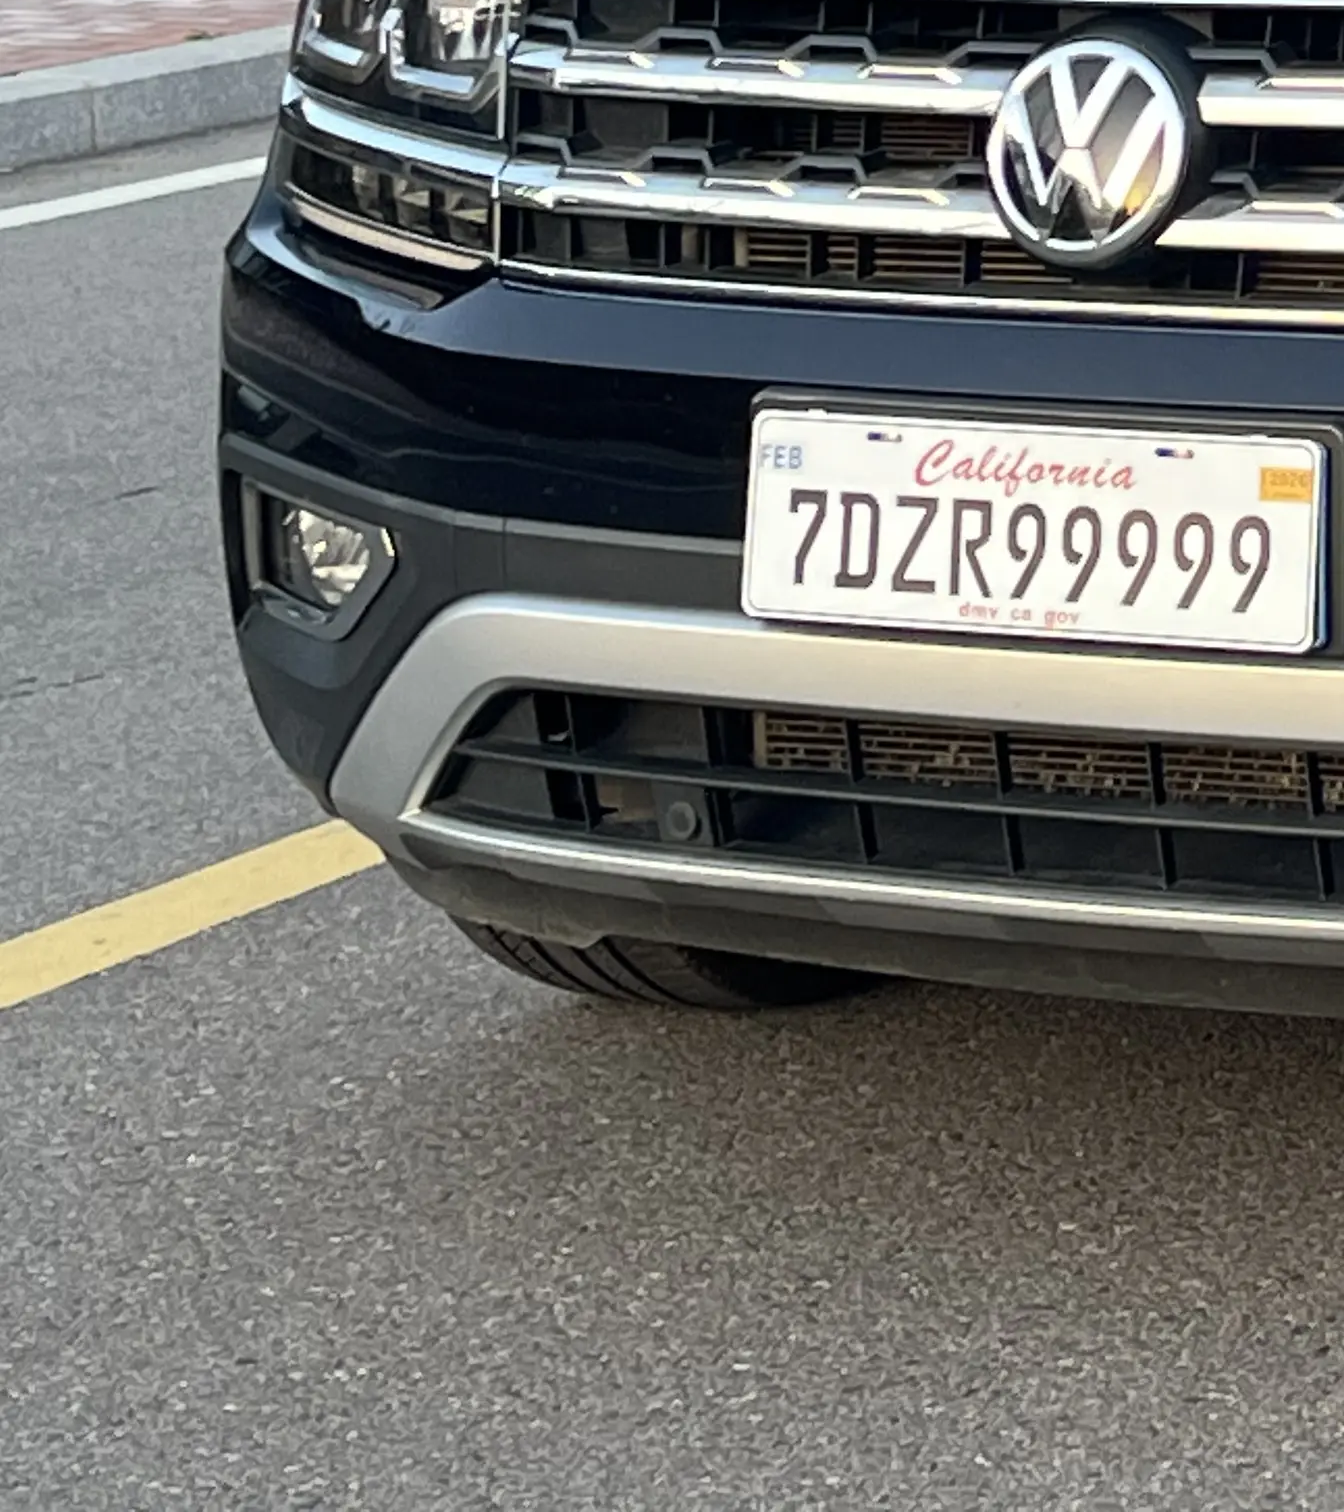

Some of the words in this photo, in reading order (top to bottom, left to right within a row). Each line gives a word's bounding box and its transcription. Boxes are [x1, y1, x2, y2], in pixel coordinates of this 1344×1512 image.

[760, 444, 803, 469] FEB
[915, 439, 1137, 497] California
[789, 488, 1271, 613] 7DZR99999
[959, 601, 999, 619] dmv
[1010, 608, 1032, 621] ca
[1044, 610, 1080, 630] gov
